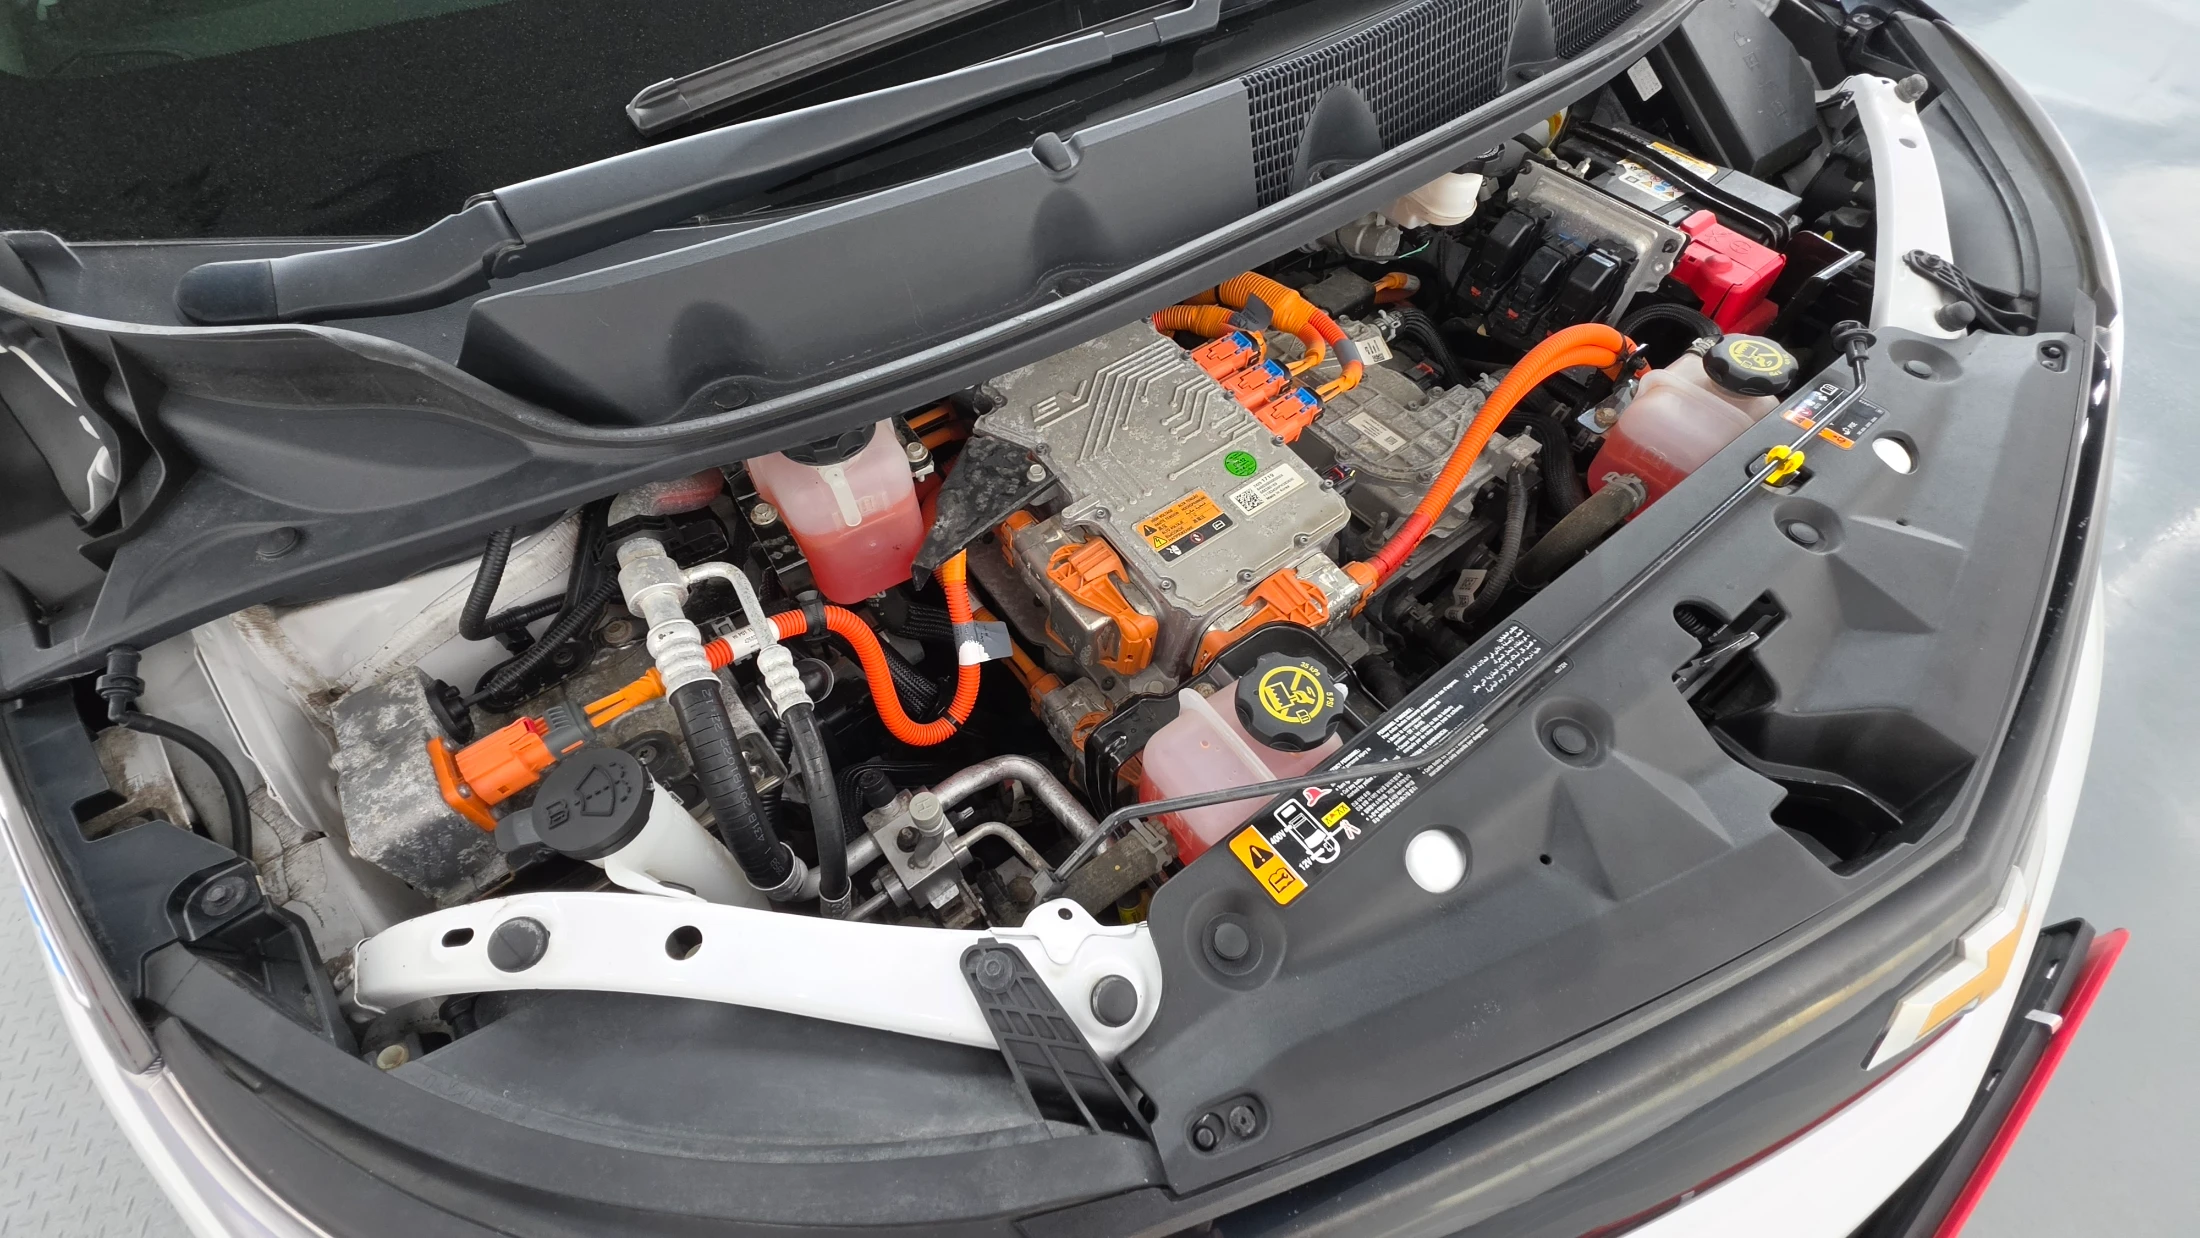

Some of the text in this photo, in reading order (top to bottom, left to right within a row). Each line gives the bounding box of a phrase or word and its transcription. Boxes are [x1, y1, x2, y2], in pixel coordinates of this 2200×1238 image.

[1300, 661, 1321, 677] 35 kPa
[1325, 696, 1335, 708] PSI
[915, 796, 933, 813] H
[1269, 829, 1287, 845] 400V
[1298, 857, 1313, 871] 12V
